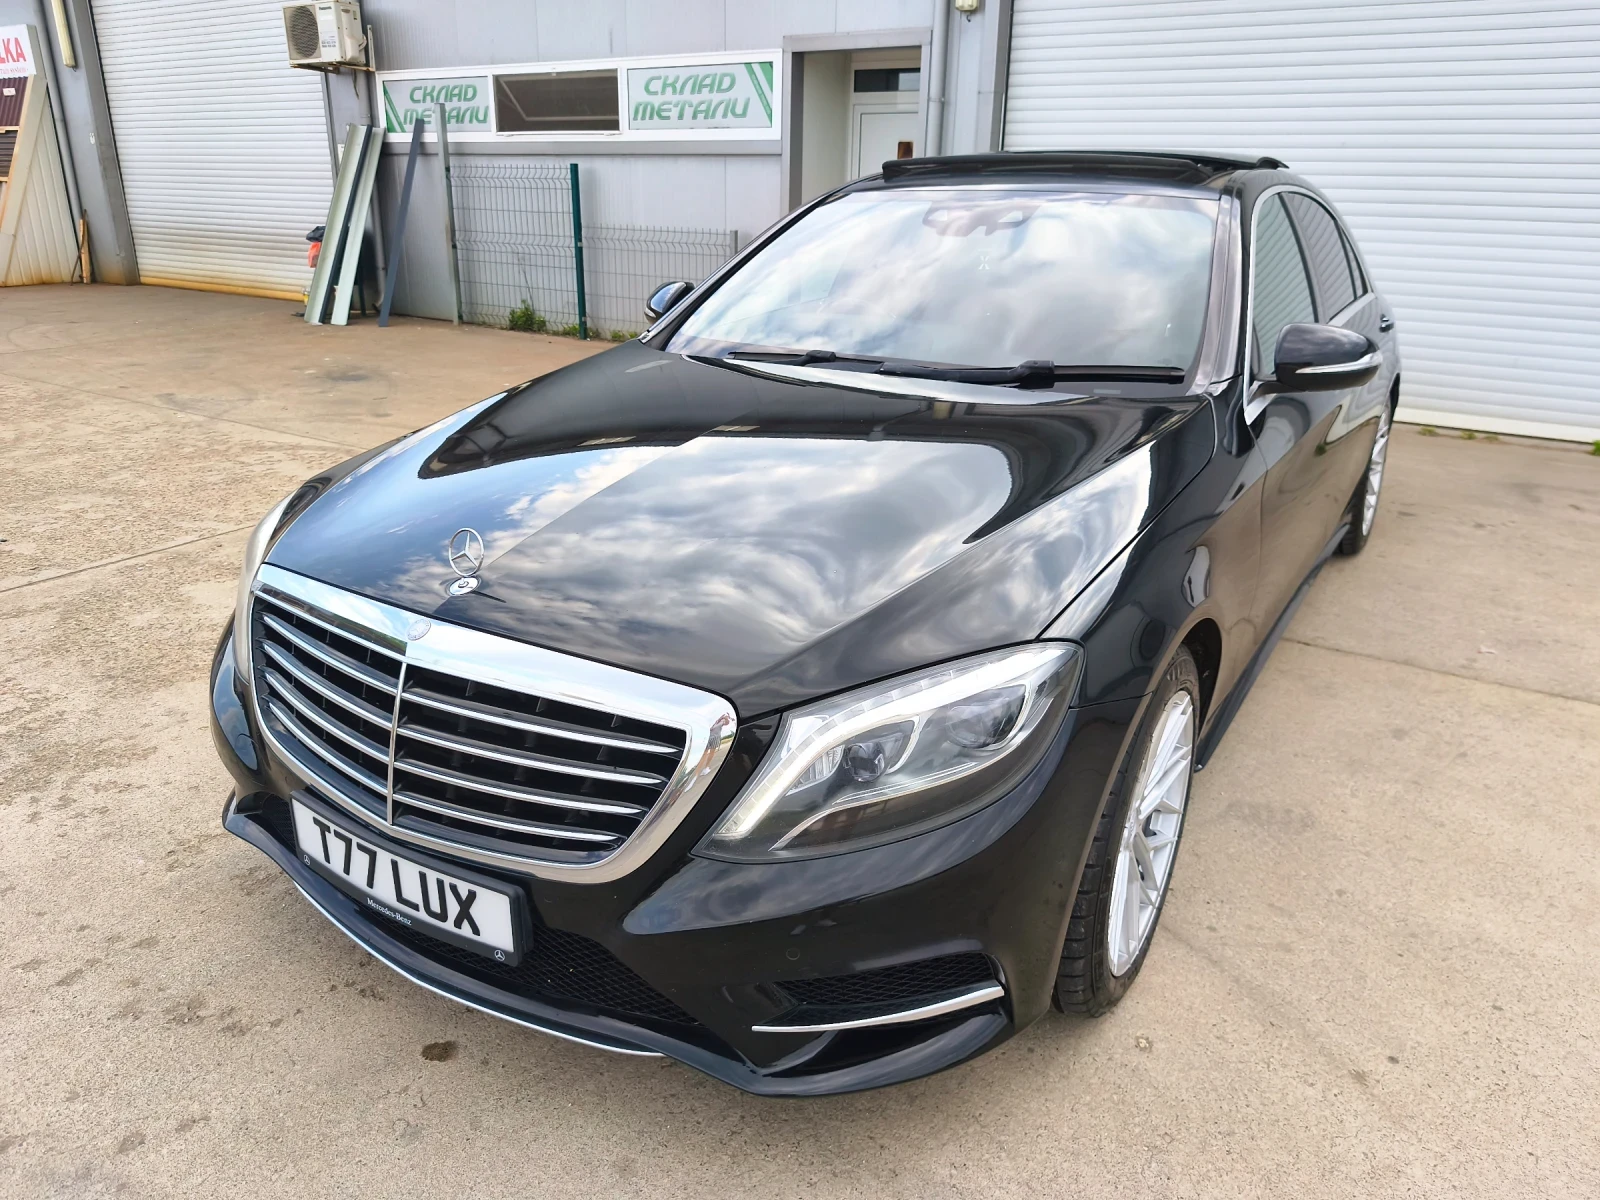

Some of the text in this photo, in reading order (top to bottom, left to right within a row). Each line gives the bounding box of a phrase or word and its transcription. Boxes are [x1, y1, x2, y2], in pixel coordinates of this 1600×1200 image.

[644, 73, 736, 95] СКЛАД
[404, 106, 489, 125] МЕАЛИ
[313, 816, 480, 936] T77 LUX
[367, 897, 412, 925] Mercedes-Benz
